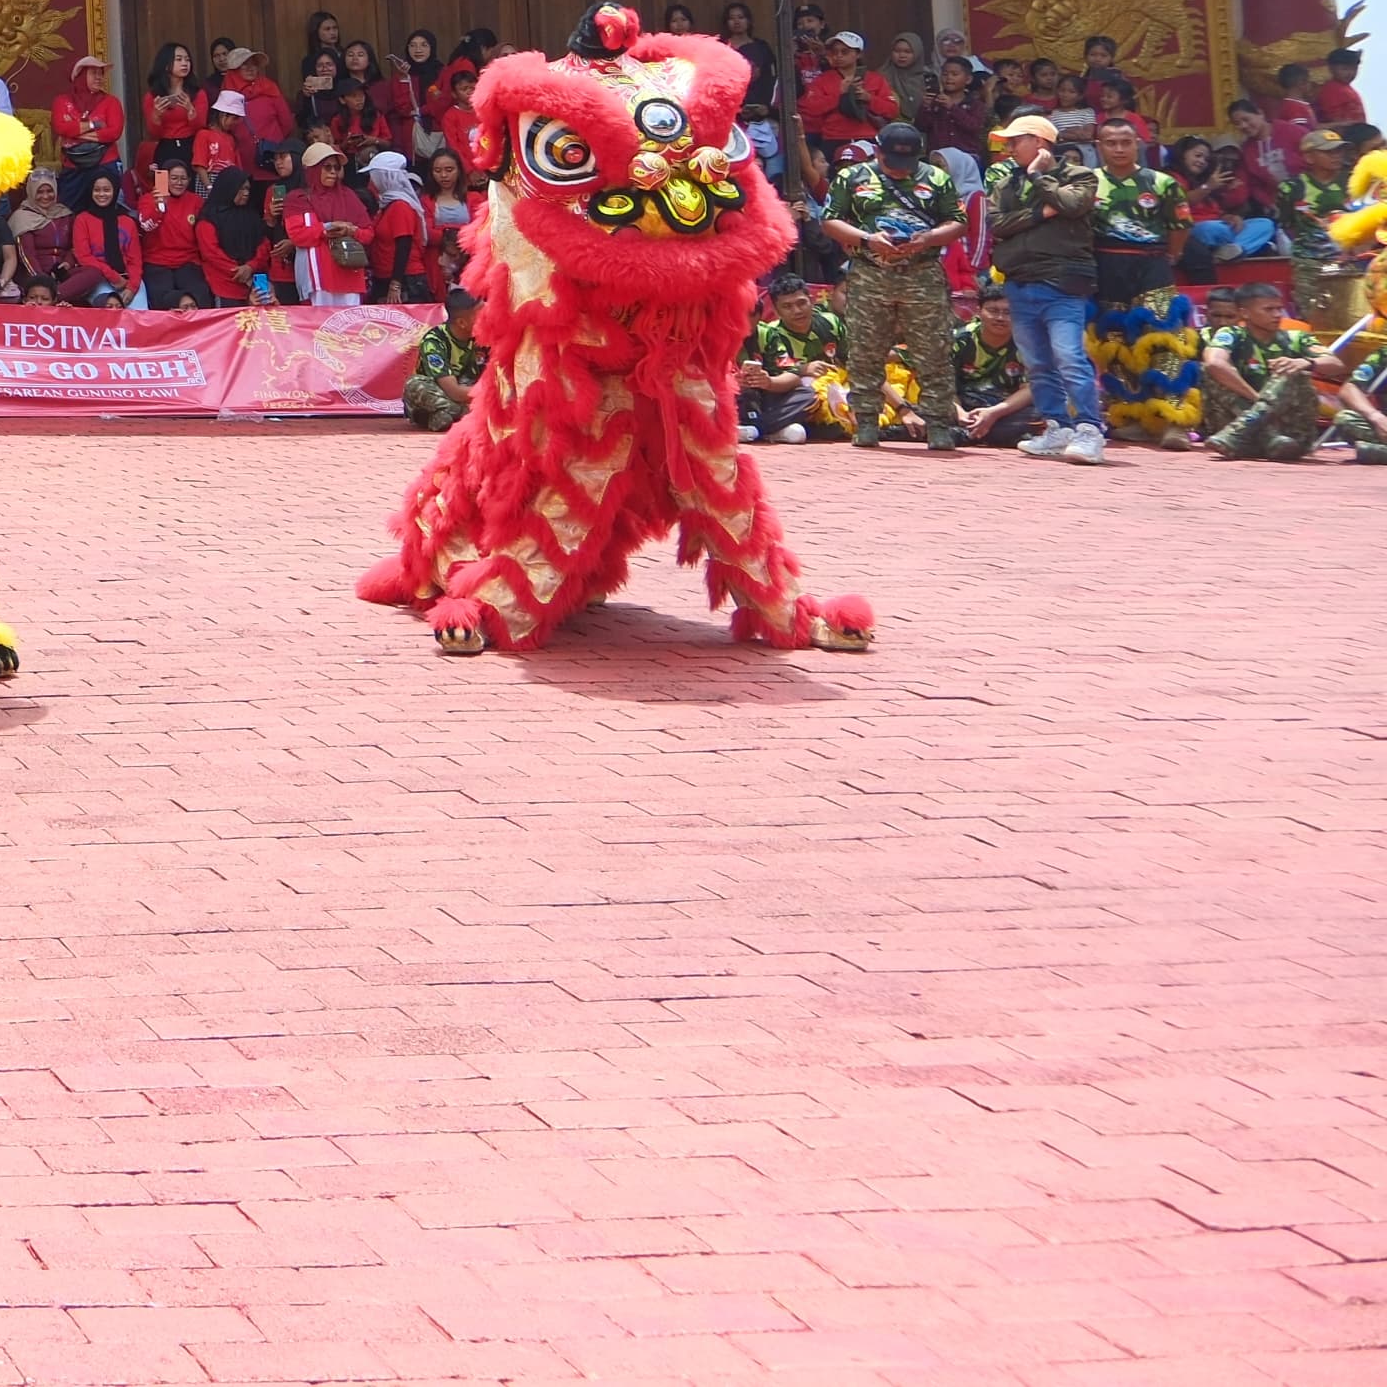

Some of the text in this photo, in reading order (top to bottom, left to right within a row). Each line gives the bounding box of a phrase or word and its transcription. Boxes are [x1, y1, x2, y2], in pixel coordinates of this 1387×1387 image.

[236, 309, 291, 334] 恭喜
[3, 323, 138, 351] FESTIVAL
[49, 362, 99, 380] GO
[109, 360, 189, 380] MEH
[67, 388, 135, 398] GUNUNG
[140, 387, 180, 398] KAWI
